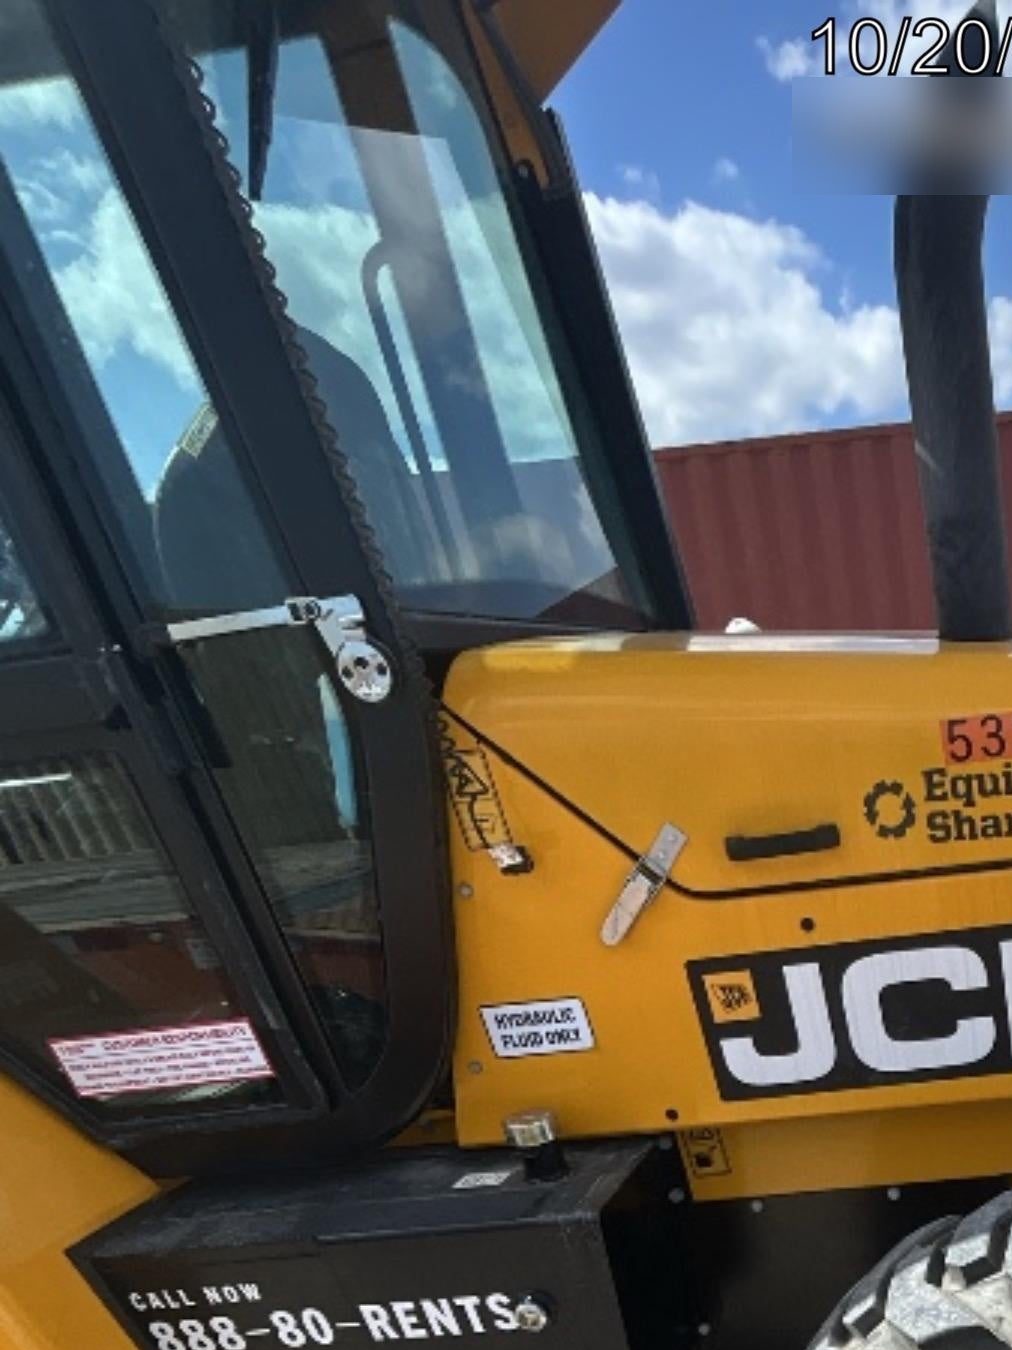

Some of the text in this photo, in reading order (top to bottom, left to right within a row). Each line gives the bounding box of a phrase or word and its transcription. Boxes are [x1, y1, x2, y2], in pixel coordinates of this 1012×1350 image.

[494, 1007, 577, 1030] HYDRAULIC
[500, 1028, 582, 1050] FLUID ONLY
[128, 1282, 263, 1312] CALL NOW
